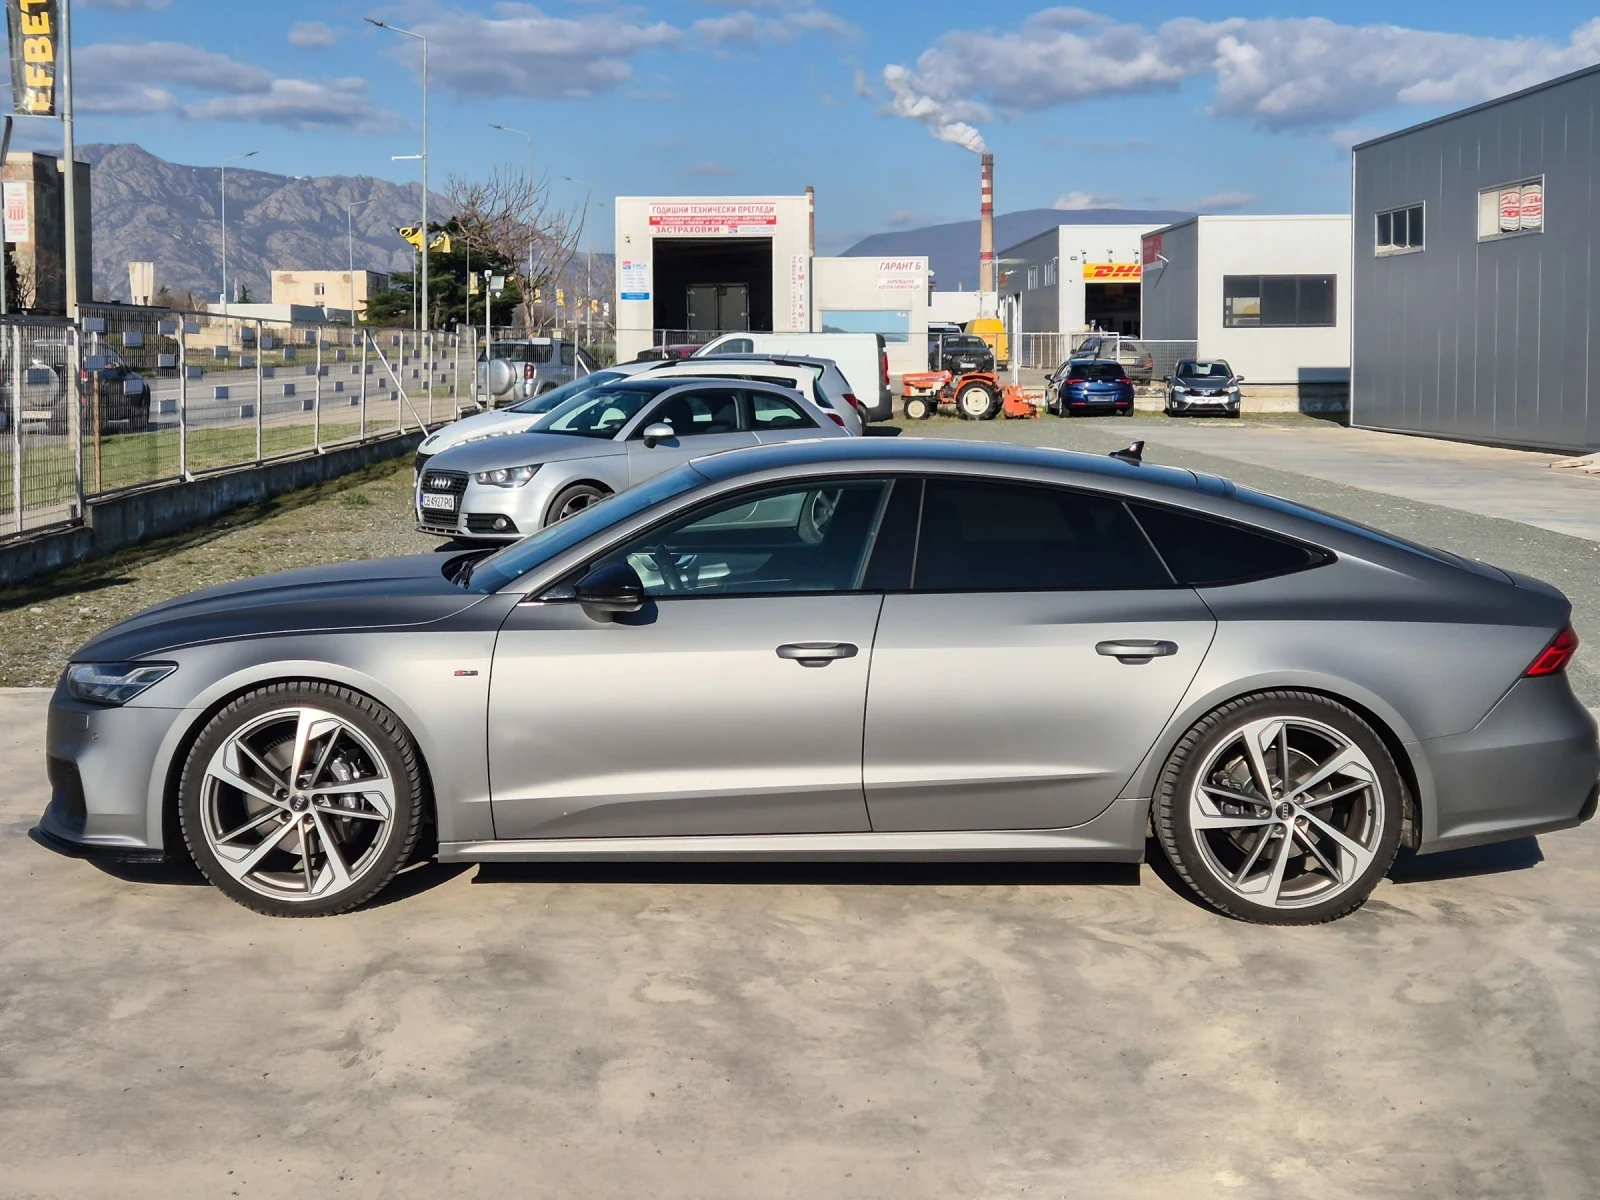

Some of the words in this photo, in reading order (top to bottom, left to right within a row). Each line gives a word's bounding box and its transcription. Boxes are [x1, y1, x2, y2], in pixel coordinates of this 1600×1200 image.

[652, 206, 689, 215] ГОДИШНИ
[690, 206, 736, 214] ТЕХНИЧЕСКИ
[737, 205, 774, 214] ПРЕГЛЕДИ
[655, 226, 720, 234] ЗАСТРАХОВКИ
[879, 261, 914, 271] ГАРАНТ
[914, 261, 922, 271] Б
[431, 496, 444, 508] 4927
